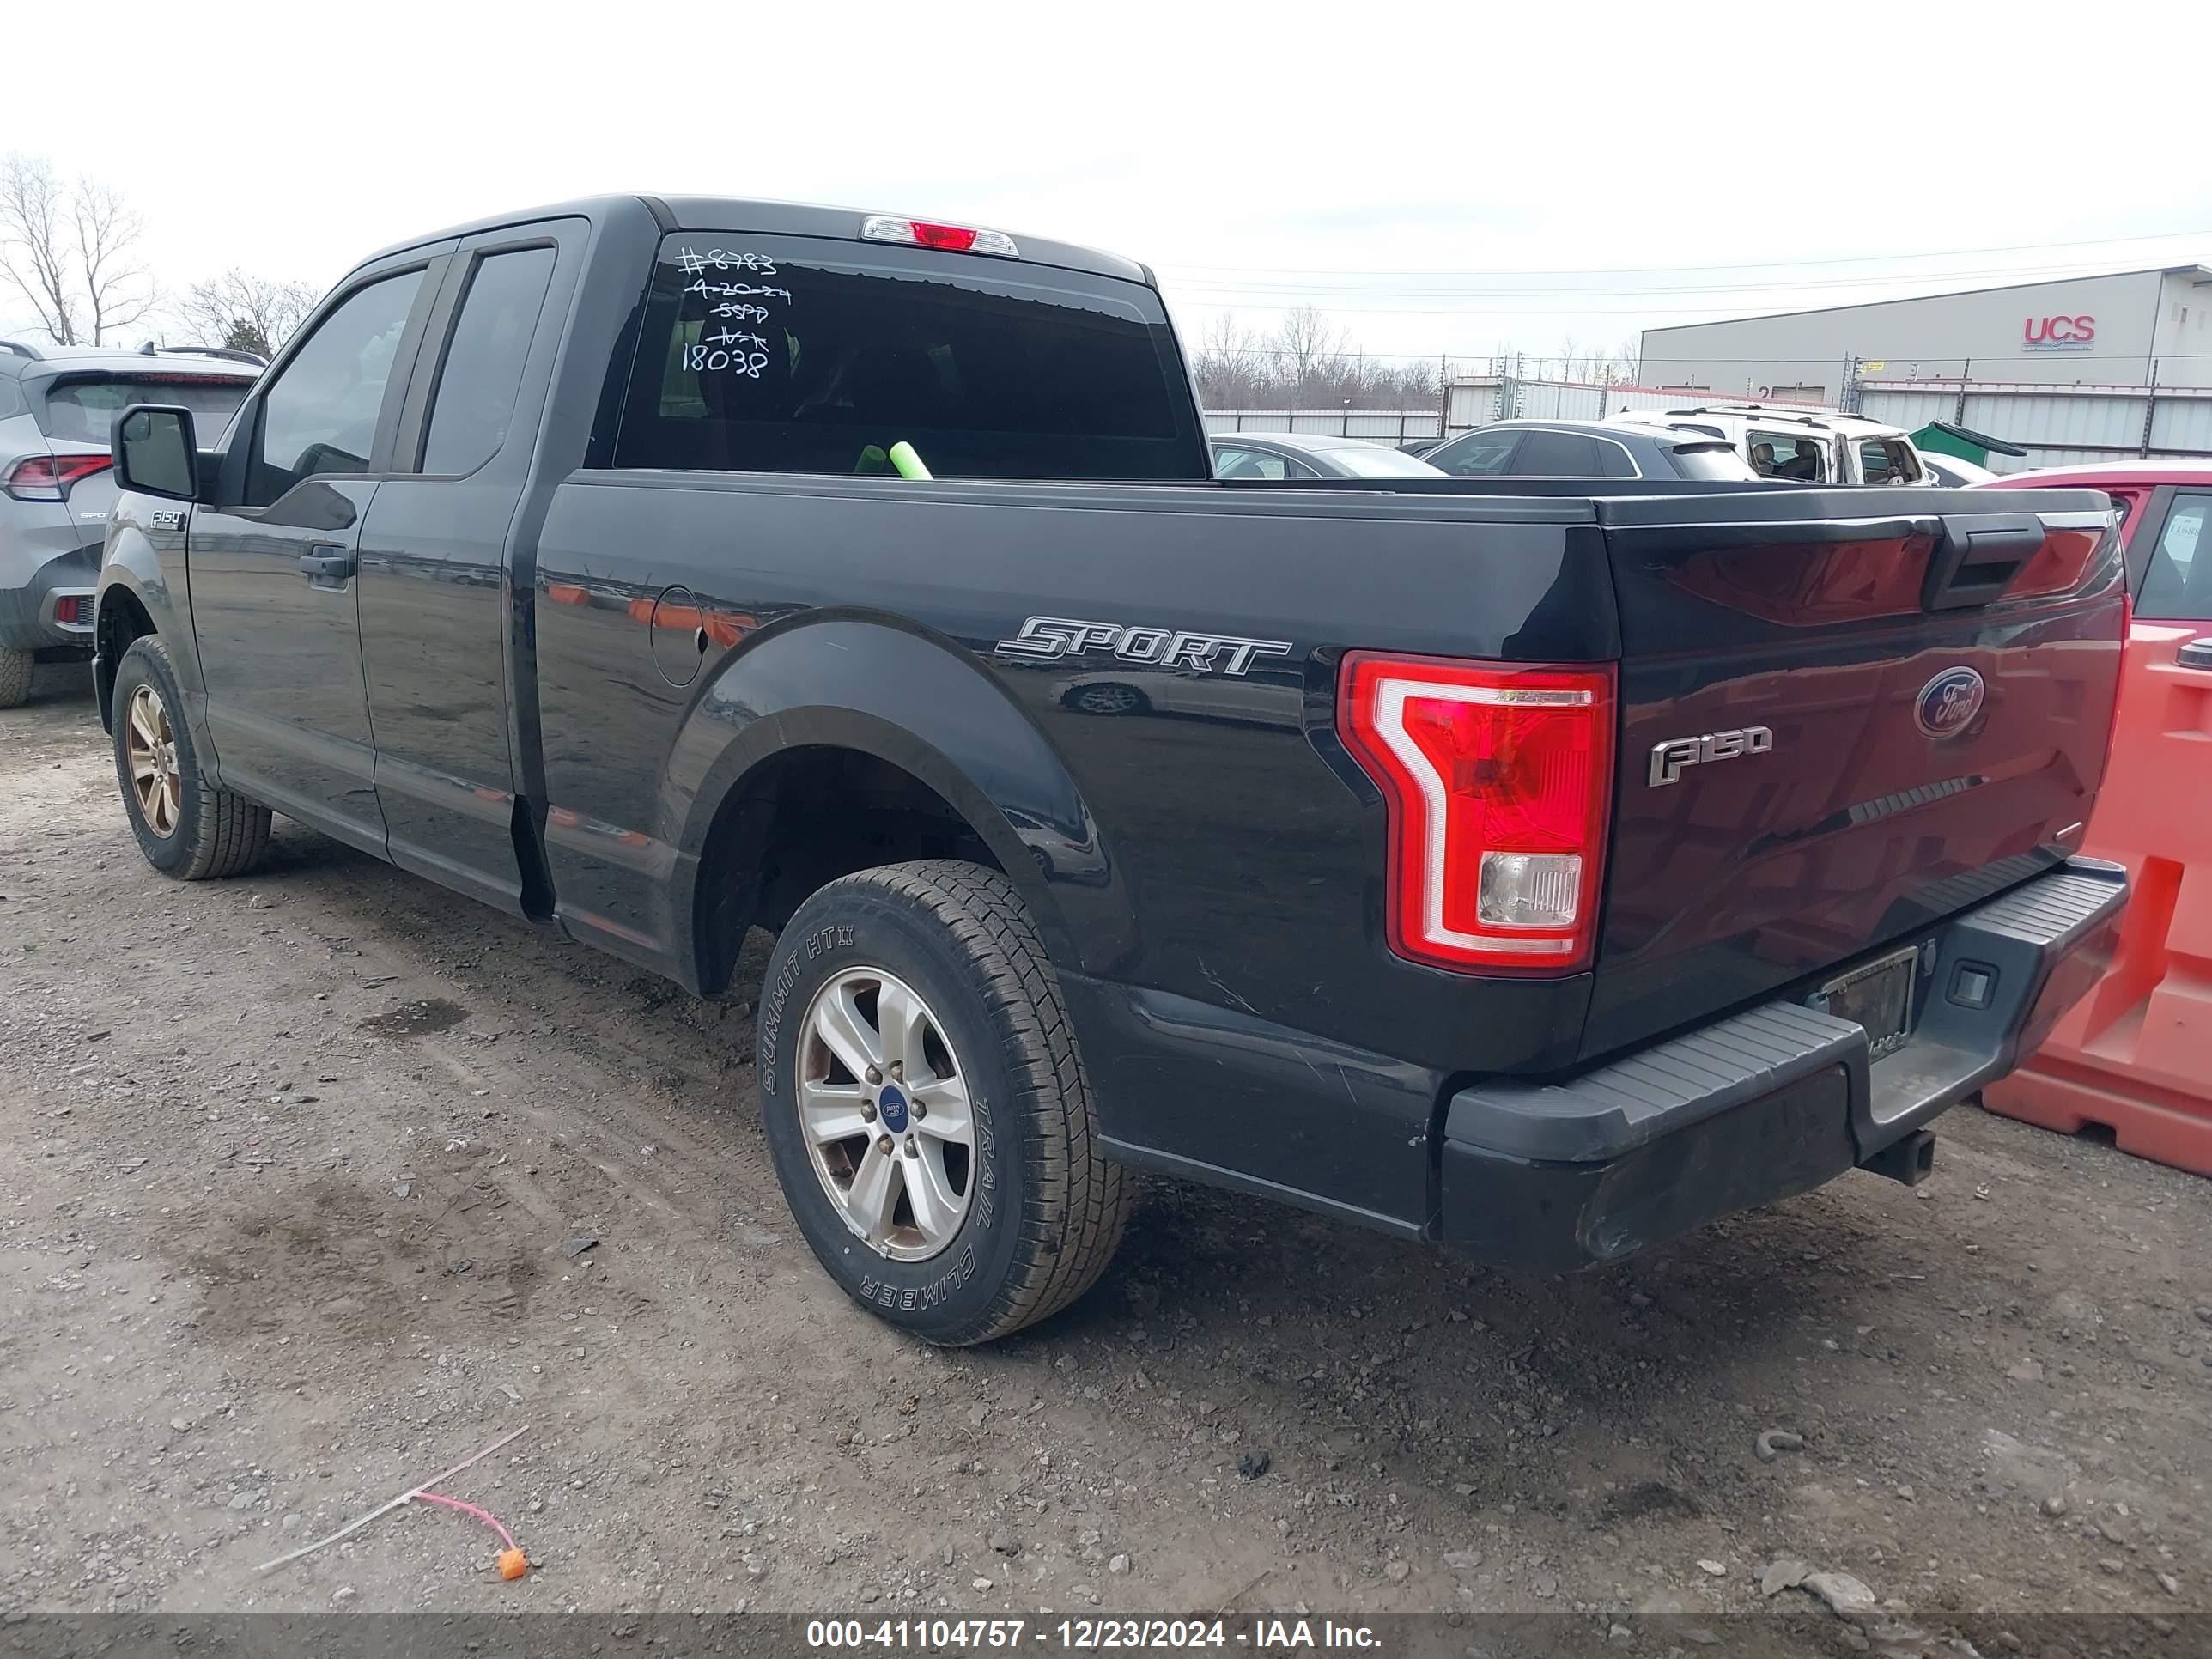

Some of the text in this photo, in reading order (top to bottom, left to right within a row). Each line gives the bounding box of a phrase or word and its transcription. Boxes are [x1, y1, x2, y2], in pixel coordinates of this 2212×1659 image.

[2024, 315, 2095, 341] UCS
[683, 343, 769, 379] 18038
[151, 511, 182, 529] F150
[994, 616, 1293, 676] SPORT
[1936, 683, 1975, 723] Ford
[1649, 725, 1774, 787] F150
[762, 949, 801, 1096] SUMMIT
[859, 1097, 998, 1312] TRAIL CLIMBER
